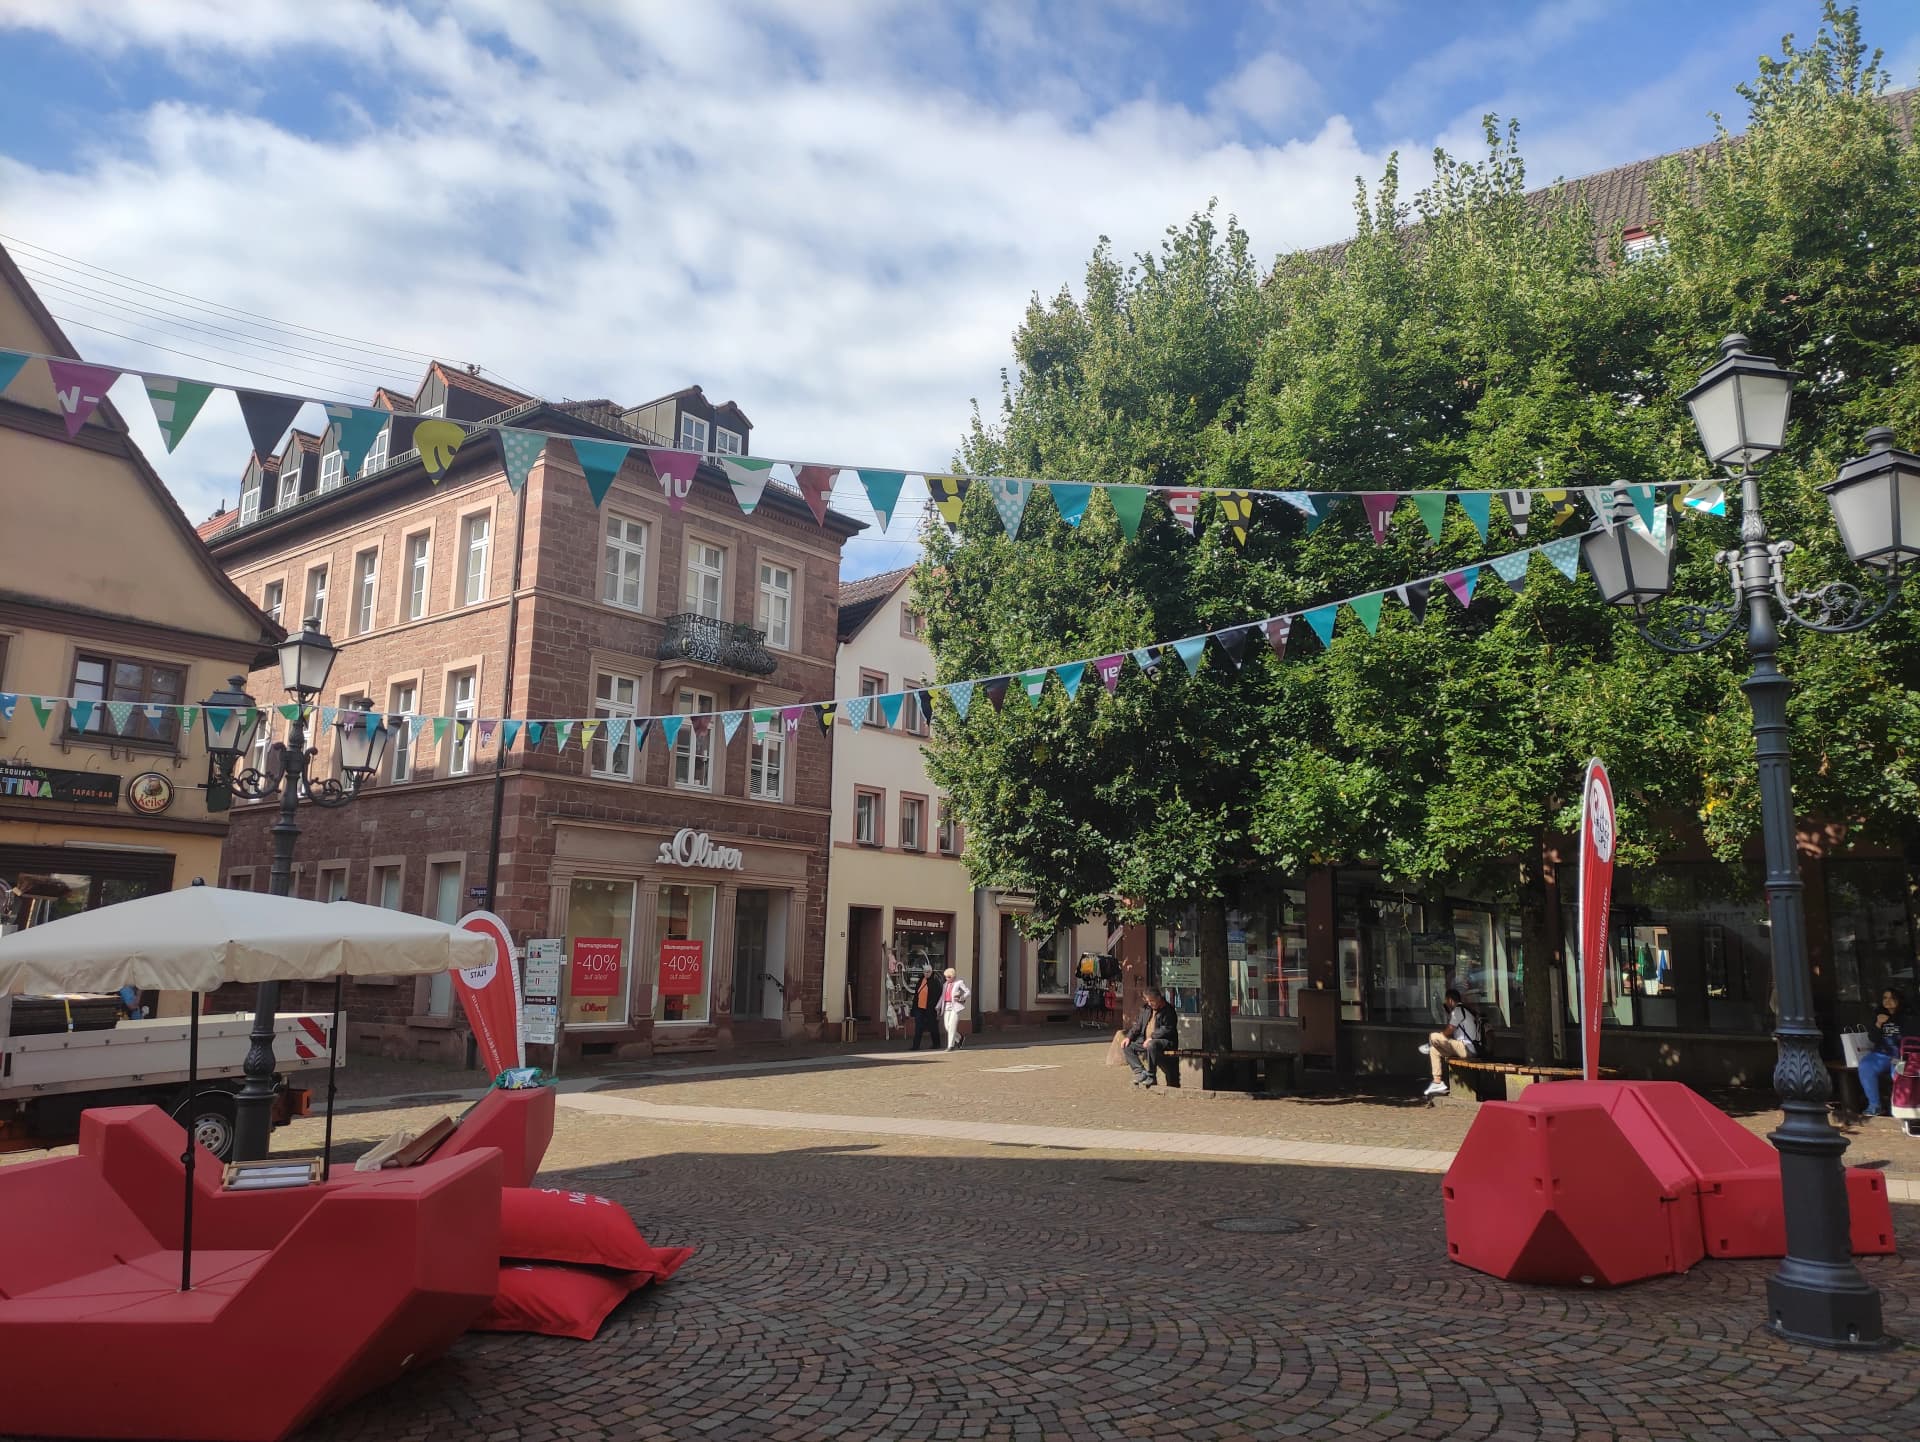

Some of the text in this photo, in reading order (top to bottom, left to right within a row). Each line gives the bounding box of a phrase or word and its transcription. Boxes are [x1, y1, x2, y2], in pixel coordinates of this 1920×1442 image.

[0, 777, 52, 798] TINA
[72, 788, 113, 799] TAPAS-BAR
[656, 828, 744, 871] s.Oliver
[577, 954, 617, 971] -40%
[663, 955, 700, 971] -40%
